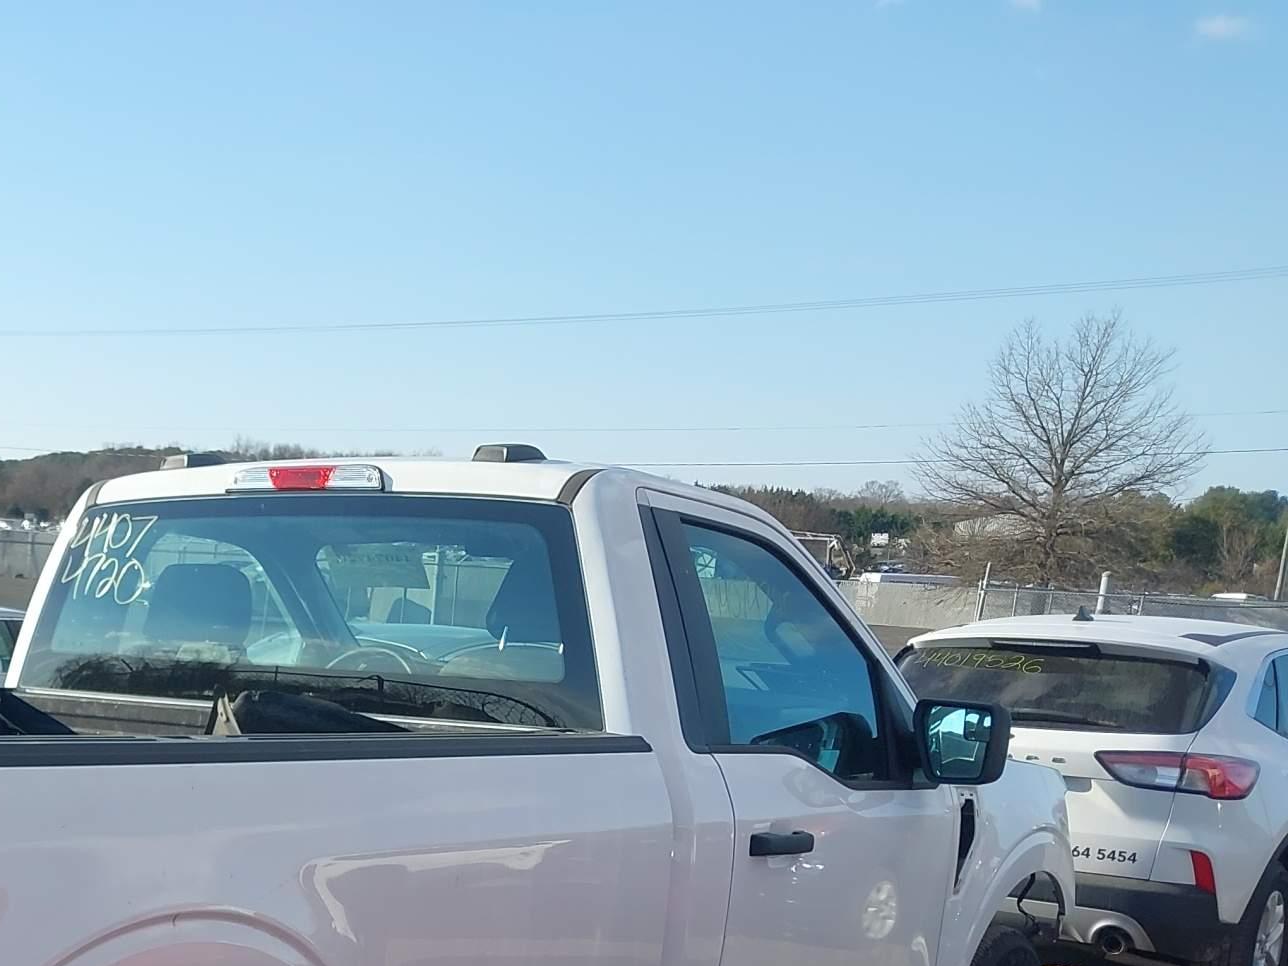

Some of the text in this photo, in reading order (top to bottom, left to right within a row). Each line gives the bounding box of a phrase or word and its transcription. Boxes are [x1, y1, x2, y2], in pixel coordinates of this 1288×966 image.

[70, 512, 159, 558] 4407
[60, 554, 146, 605] 4720
[913, 650, 1046, 675] 44019526
[1096, 848, 1137, 864] 5454
